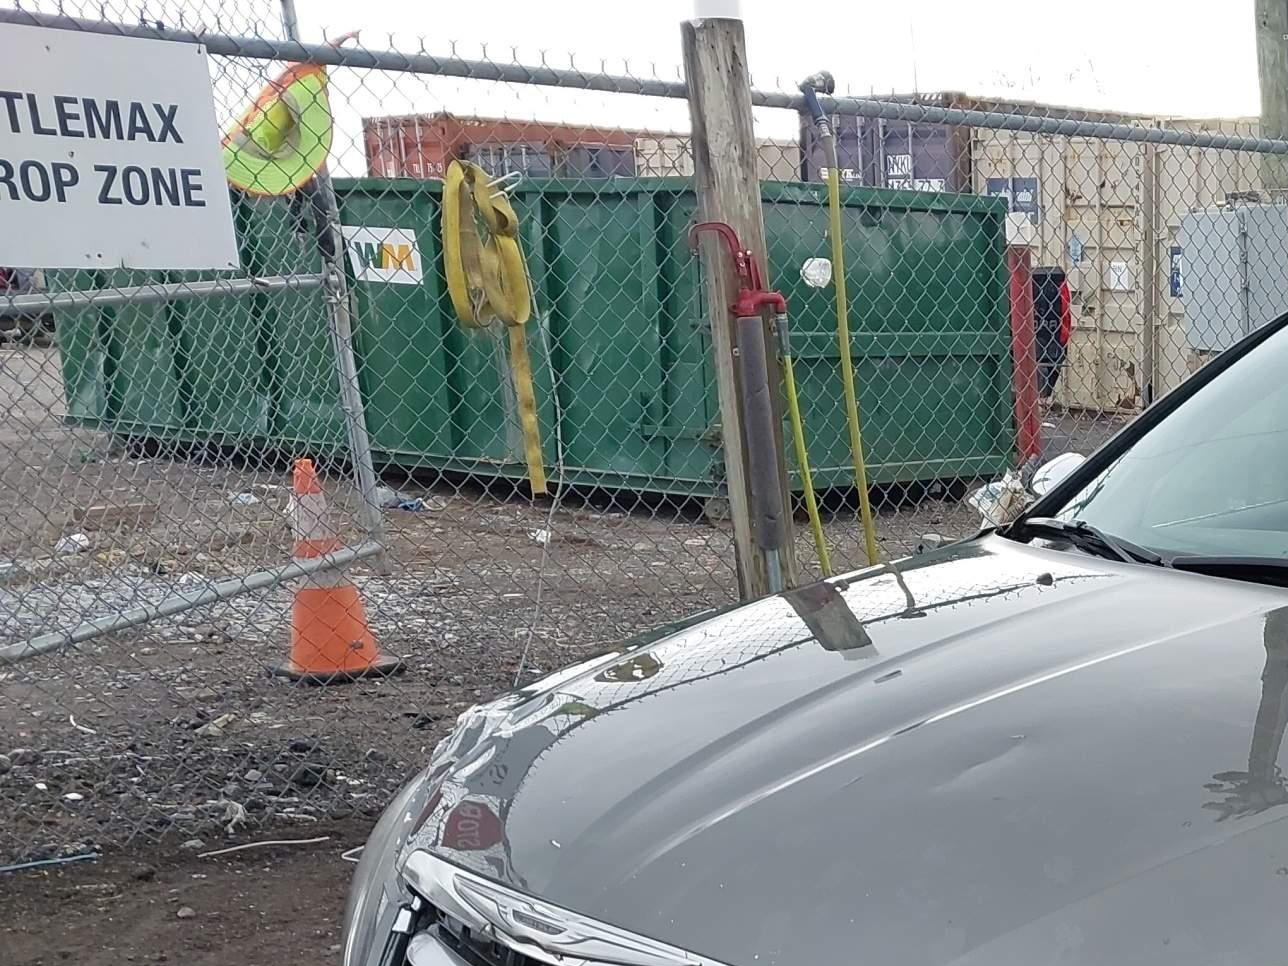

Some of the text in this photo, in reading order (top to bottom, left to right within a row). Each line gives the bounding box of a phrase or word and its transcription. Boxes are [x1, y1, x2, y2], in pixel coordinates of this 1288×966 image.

[0, 90, 185, 144] TLEMAX
[0, 159, 207, 208] ROP ZONE
[353, 241, 417, 272] WM
